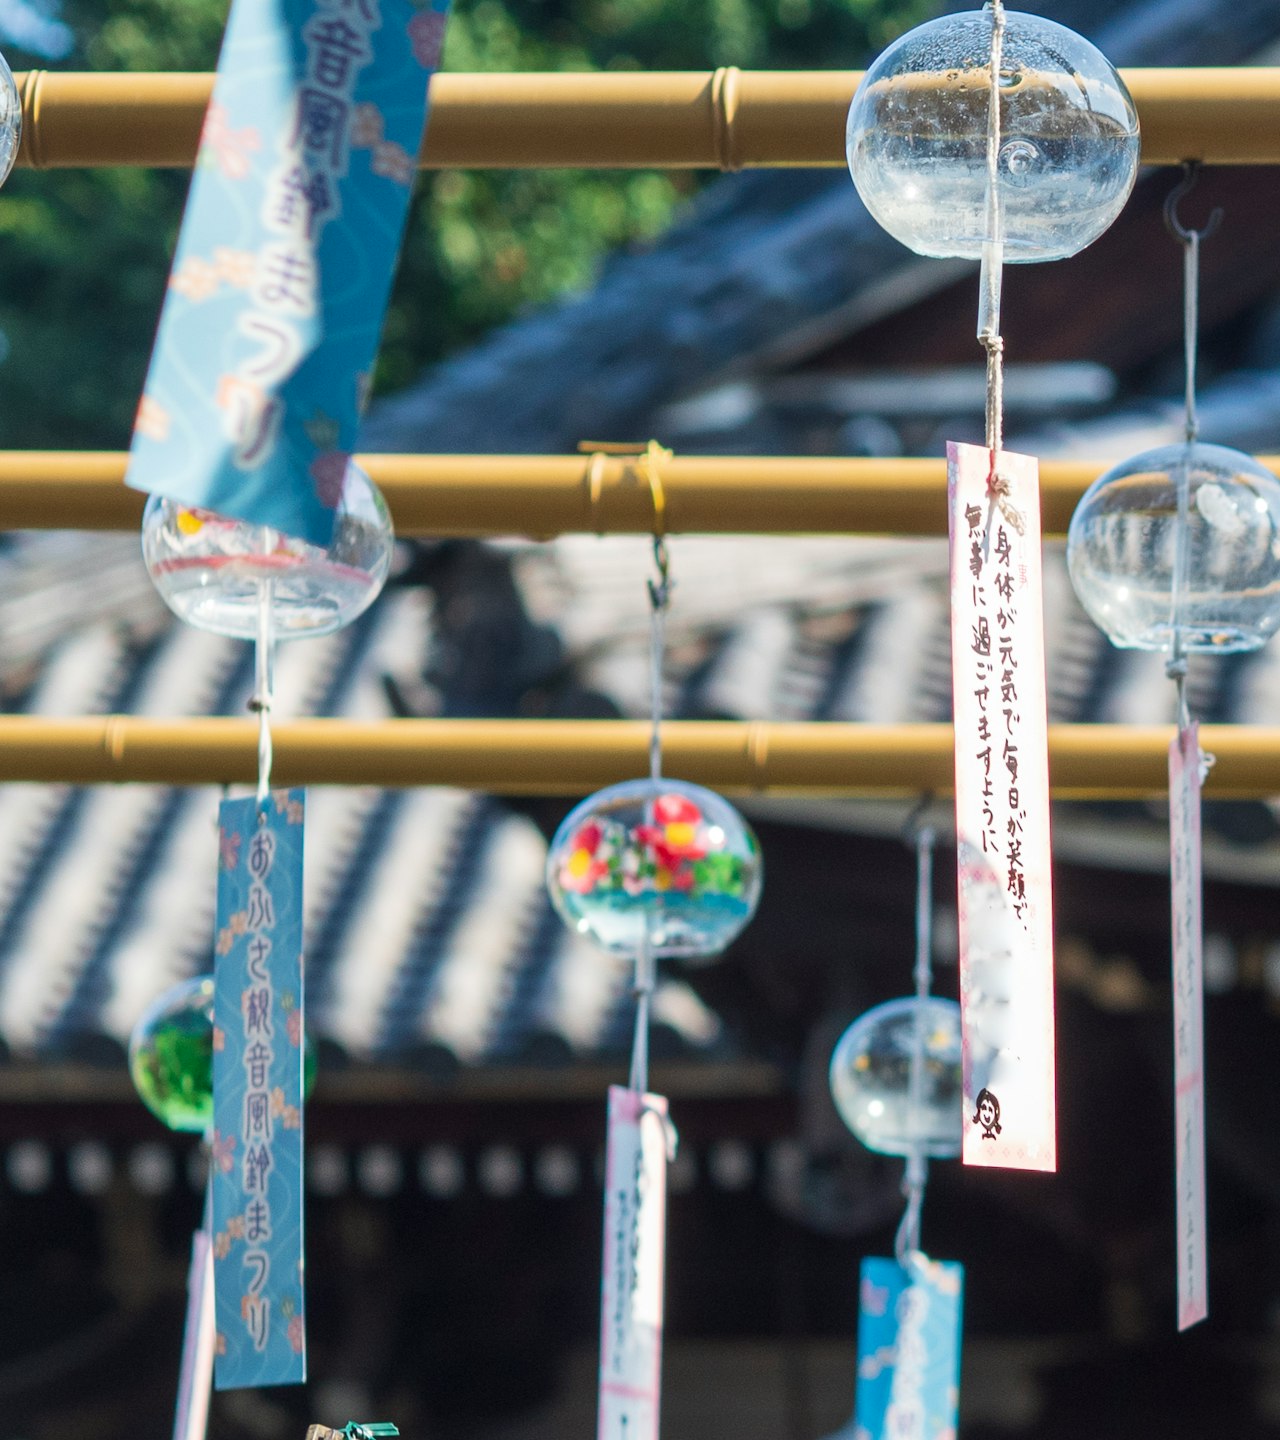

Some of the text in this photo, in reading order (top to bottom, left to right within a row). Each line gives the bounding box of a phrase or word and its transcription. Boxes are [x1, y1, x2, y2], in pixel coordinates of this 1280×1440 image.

[243, 833, 275, 1350] おふさ観音風鈴まつり
